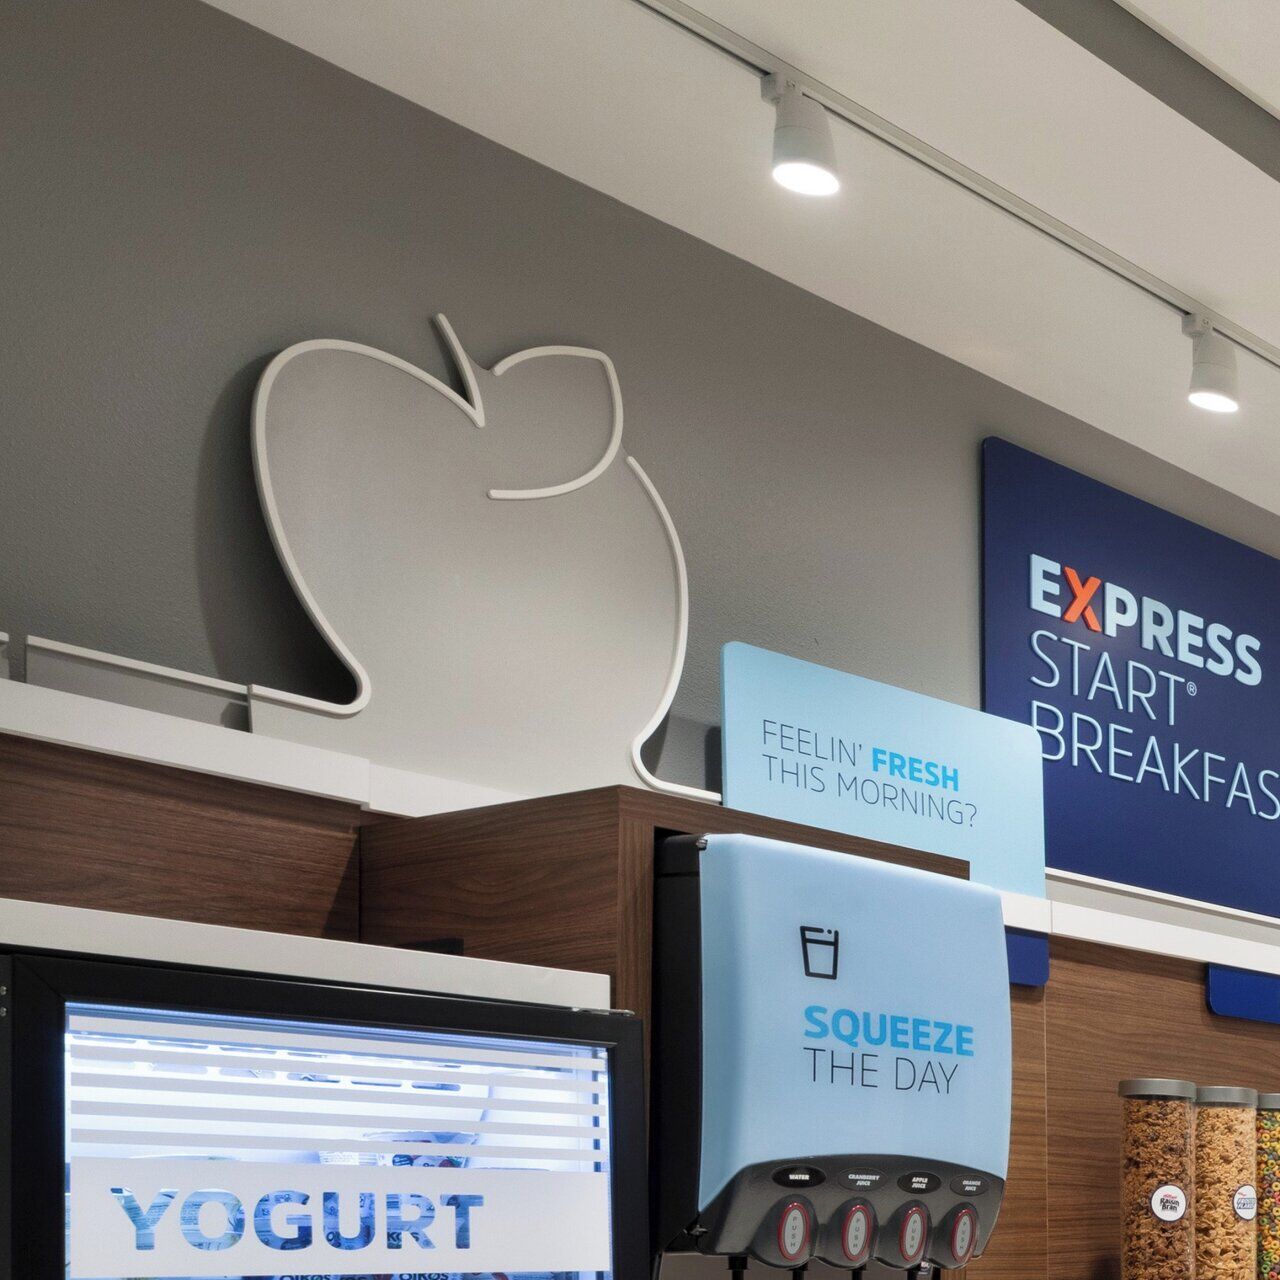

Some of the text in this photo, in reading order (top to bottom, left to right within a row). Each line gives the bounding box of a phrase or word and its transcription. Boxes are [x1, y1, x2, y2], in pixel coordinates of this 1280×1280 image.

[1030, 553, 1263, 686] EXPRESS
[763, 719, 960, 792] FEELIN' FRESH
[762, 753, 978, 828] THIS MORNING?
[804, 1005, 974, 1057] SQUEEZE
[803, 1047, 958, 1094] THE DAY
[848, 1173, 880, 1181] CRANBERRY
[110, 1187, 485, 1251] YOGURT
[790, 1216, 799, 1248] PUSH
[852, 1218, 862, 1249] PUSH
[909, 1220, 918, 1250] PUSH
[959, 1221, 968, 1250] PUSH
